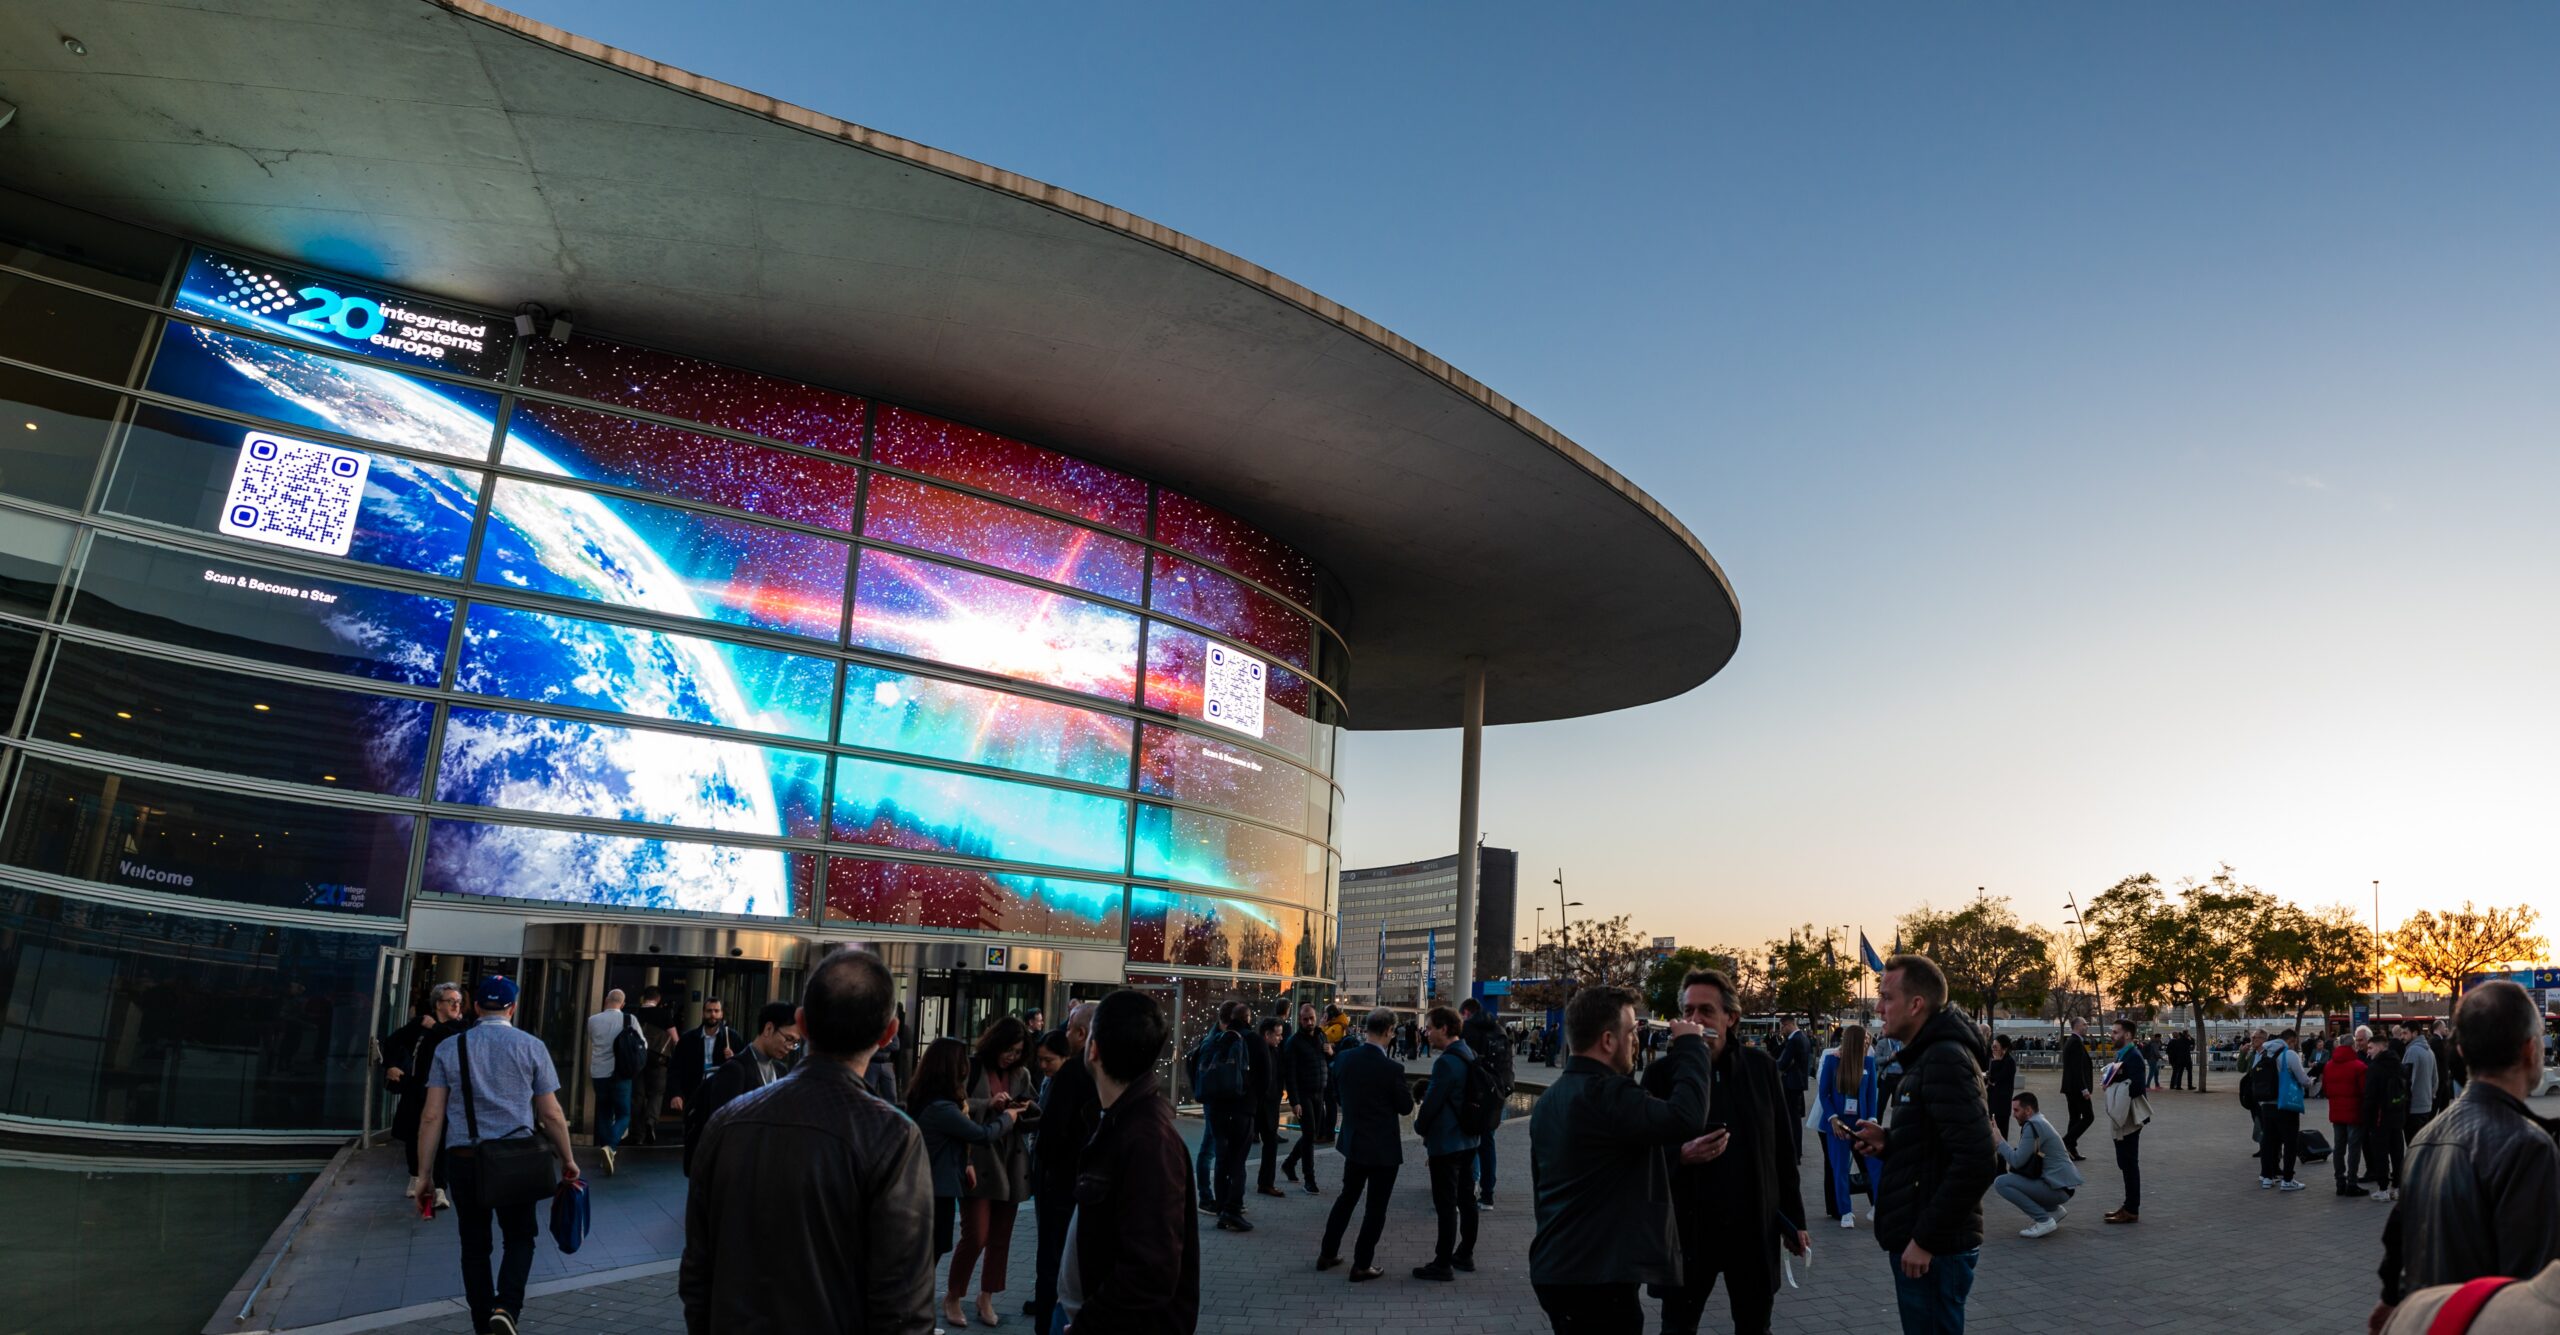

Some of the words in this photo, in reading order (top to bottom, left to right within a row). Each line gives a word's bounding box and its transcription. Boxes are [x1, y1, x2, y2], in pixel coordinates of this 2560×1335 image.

[287, 287, 385, 340] 20
[378, 302, 487, 338] integrated
[370, 333, 445, 358] europe
[400, 325, 484, 352] systems
[204, 570, 236, 585] Scan
[236, 576, 247, 588] &
[248, 578, 299, 597] Become
[300, 590, 309, 599] a
[310, 590, 338, 604] Star
[120, 860, 194, 887] Welcome
